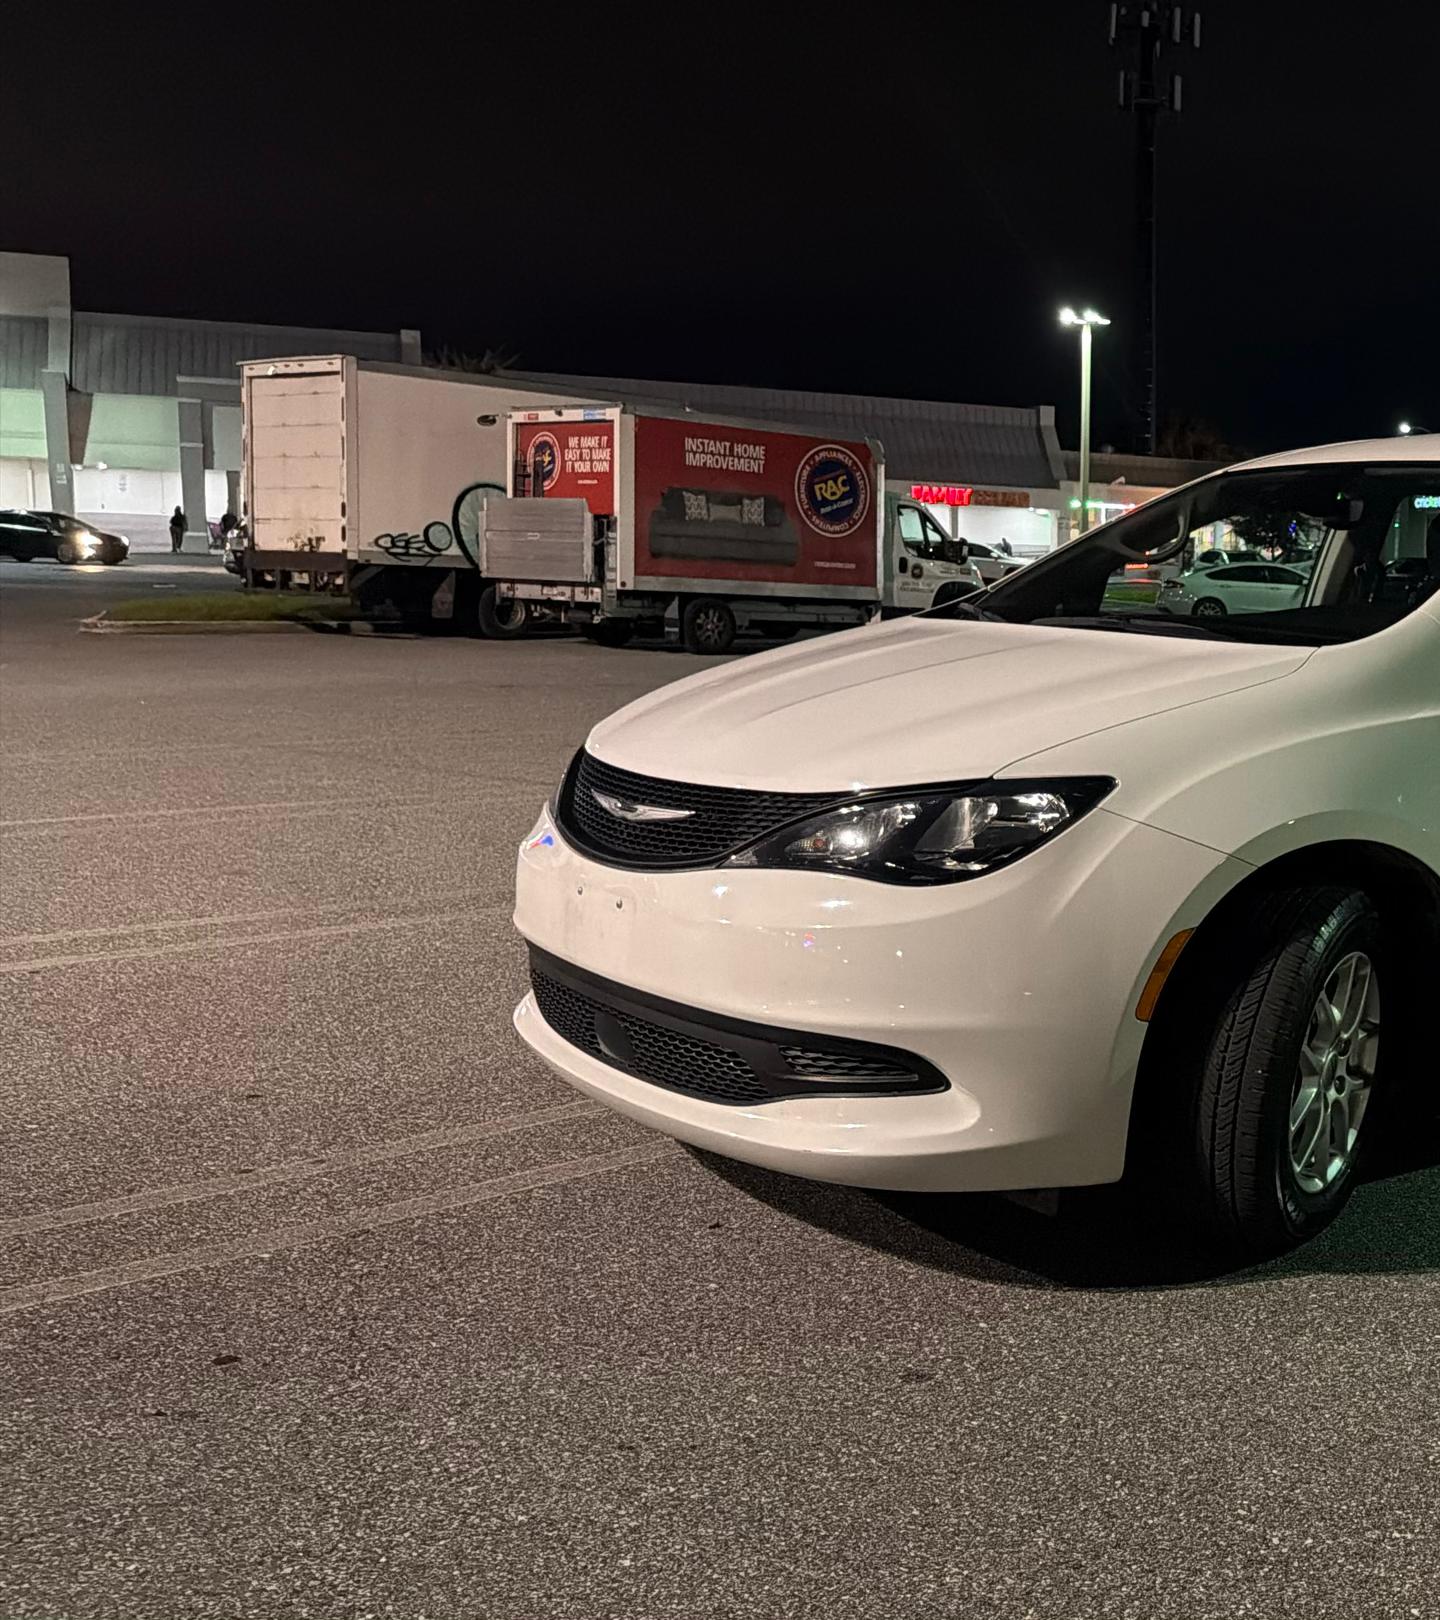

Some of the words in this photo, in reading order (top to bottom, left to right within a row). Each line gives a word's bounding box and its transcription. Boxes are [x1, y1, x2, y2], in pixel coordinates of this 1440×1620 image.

[568, 436, 579, 448] WE
[580, 436, 600, 448] MAKE
[601, 435, 608, 448] IT
[685, 437, 730, 455] INSTANT
[734, 443, 766, 459] HOME
[564, 448, 580, 460] EASY
[581, 448, 590, 460] TO
[592, 448, 611, 460] MAKE
[685, 452, 765, 473] IMPROVEMENT
[566, 461, 572, 473] IT
[574, 461, 591, 473] YOUR
[592, 461, 610, 473] OWN
[814, 475, 850, 501] RAC
